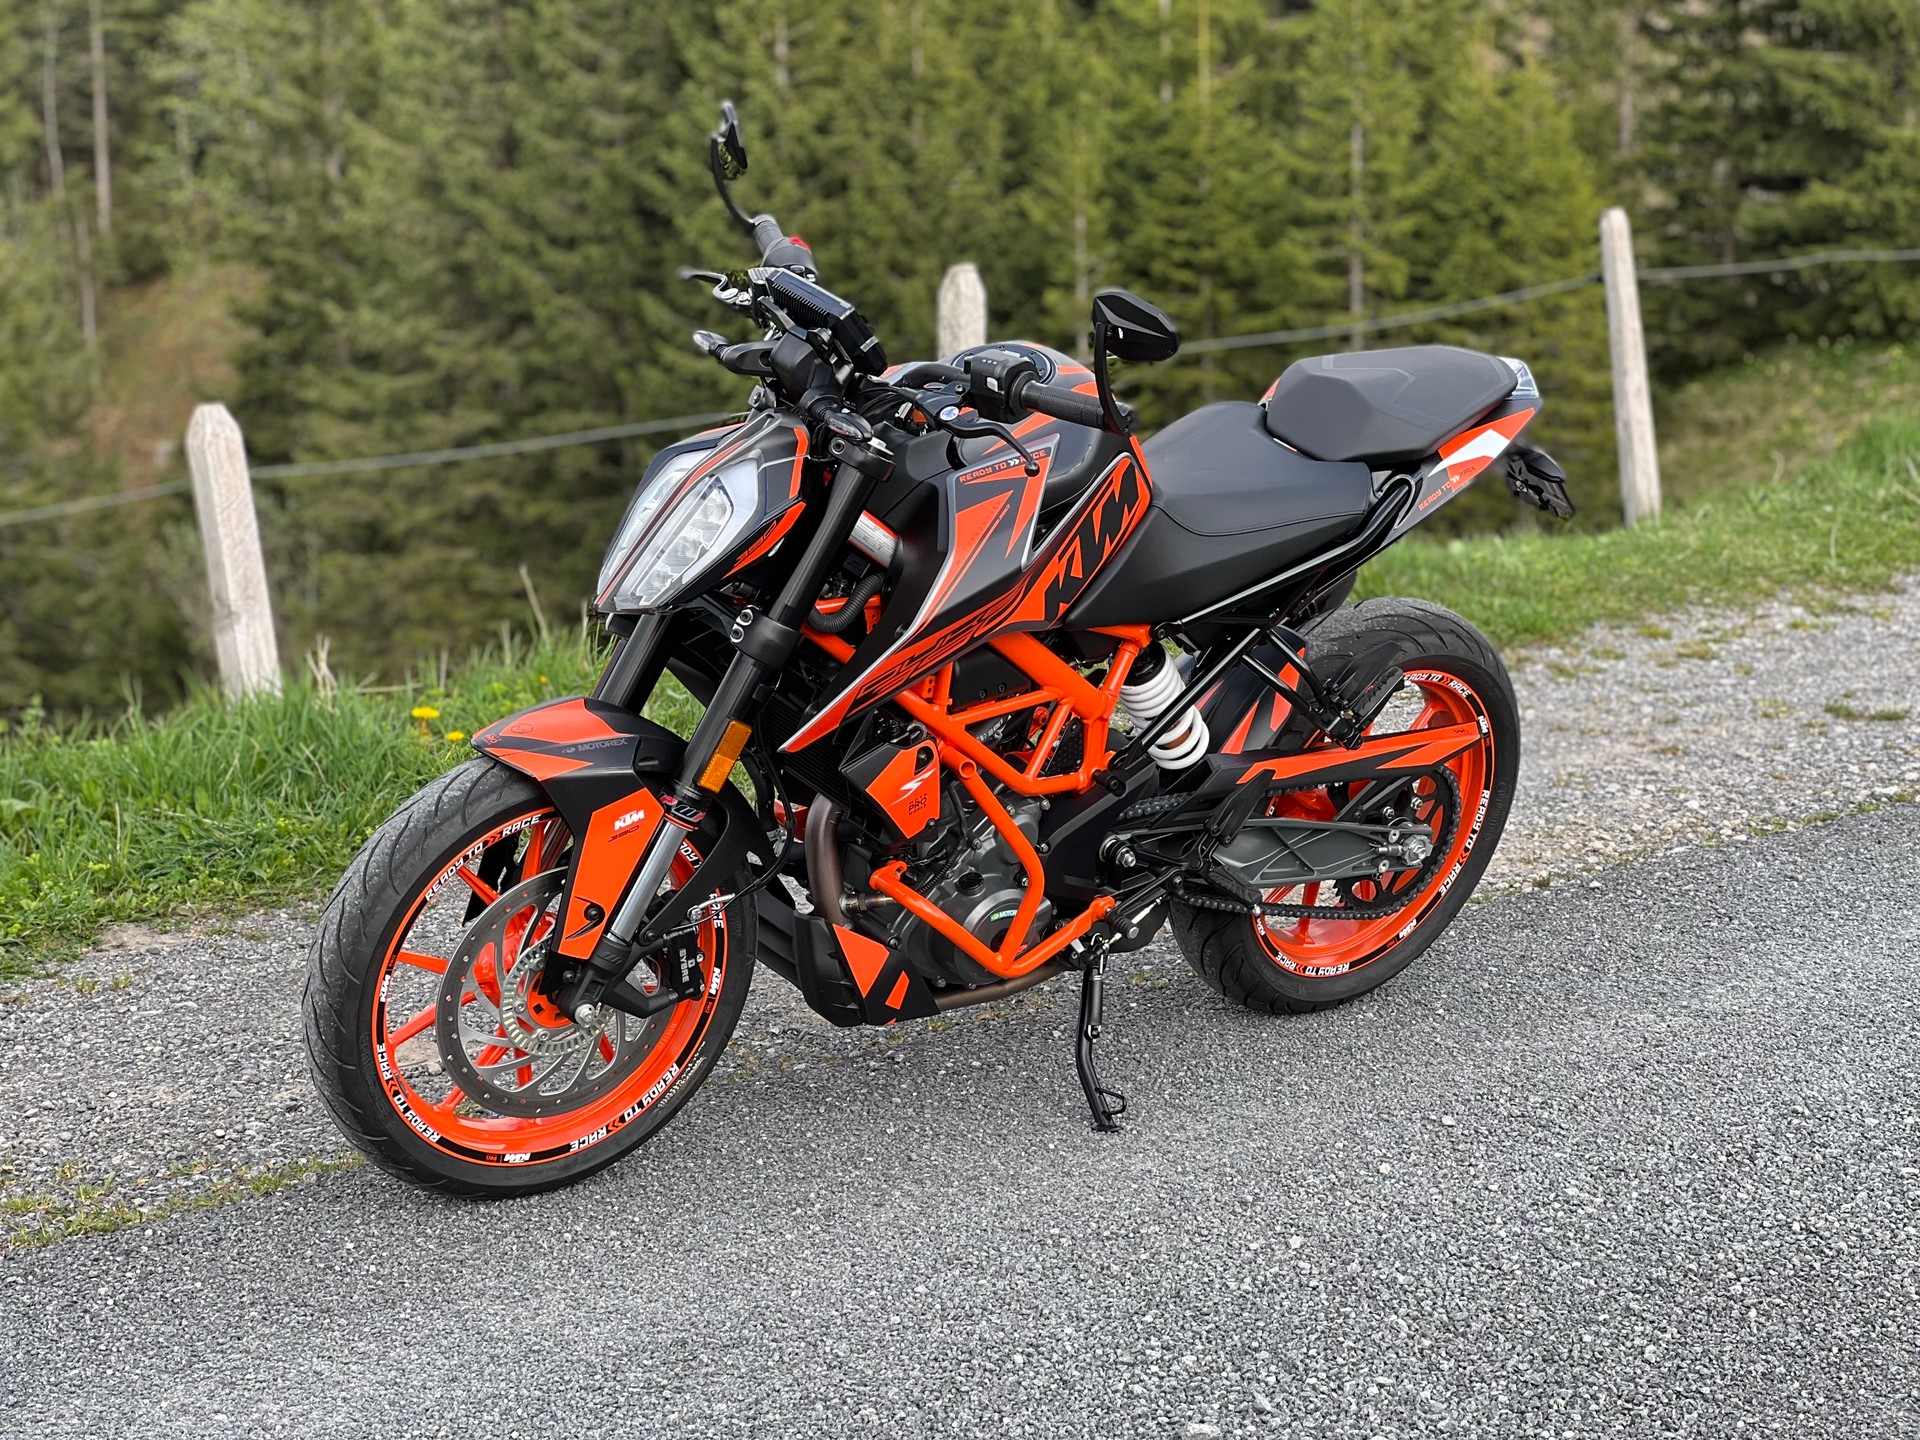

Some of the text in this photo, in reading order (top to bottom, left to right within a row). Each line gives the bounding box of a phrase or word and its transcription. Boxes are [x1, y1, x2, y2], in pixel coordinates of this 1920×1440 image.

[959, 466, 993, 483] READY
[994, 461, 1007, 471] TO
[1418, 489, 1442, 511] READY
[1441, 480, 1451, 491] TO
[1045, 462, 1140, 623] KTM
[1403, 673, 1471, 698] EADY TO RACE
[578, 738, 628, 752] MOTOREX
[613, 809, 645, 831] KTM
[607, 825, 640, 843] 390
[1439, 789, 1490, 897] READY TO RACE
[425, 814, 541, 901] READY TO RACE
[679, 948, 690, 983] BYBRE
[1275, 952, 1350, 976] READY TO RACE
[379, 974, 391, 1002] KTM
[709, 967, 722, 995] KTM
[376, 1043, 441, 1143] READY TO RACE
[642, 1062, 680, 1106] READY
[624, 1104, 642, 1122] TO
[570, 1126, 607, 1152] RACE
[503, 1152, 531, 1163] KTM
